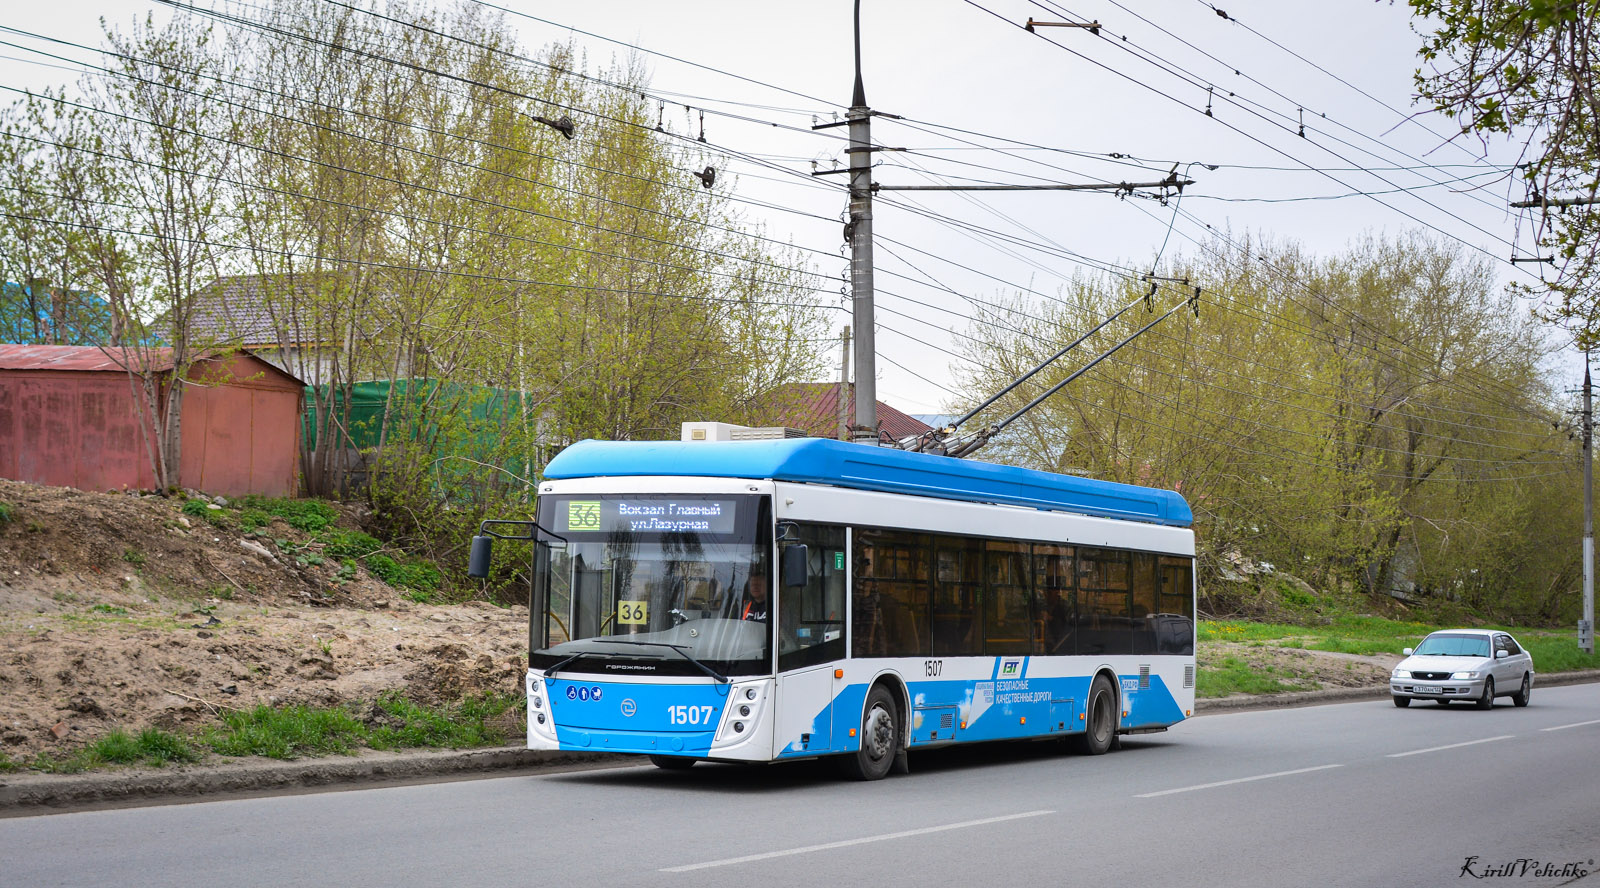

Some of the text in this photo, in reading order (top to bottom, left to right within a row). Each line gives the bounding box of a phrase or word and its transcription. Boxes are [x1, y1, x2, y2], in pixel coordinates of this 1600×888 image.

[569, 503, 600, 527] 36
[619, 503, 721, 516] Вокзал Главный
[621, 604, 643, 621] 36
[924, 660, 943, 677] 1507
[996, 680, 1029, 692] БЕЗОПАСНЫЕ
[995, 692, 1033, 704] КАЧЕСТВЕННЫЕ
[1033, 691, 1052, 704] ДОРОГИ
[667, 705, 713, 725] 1507
